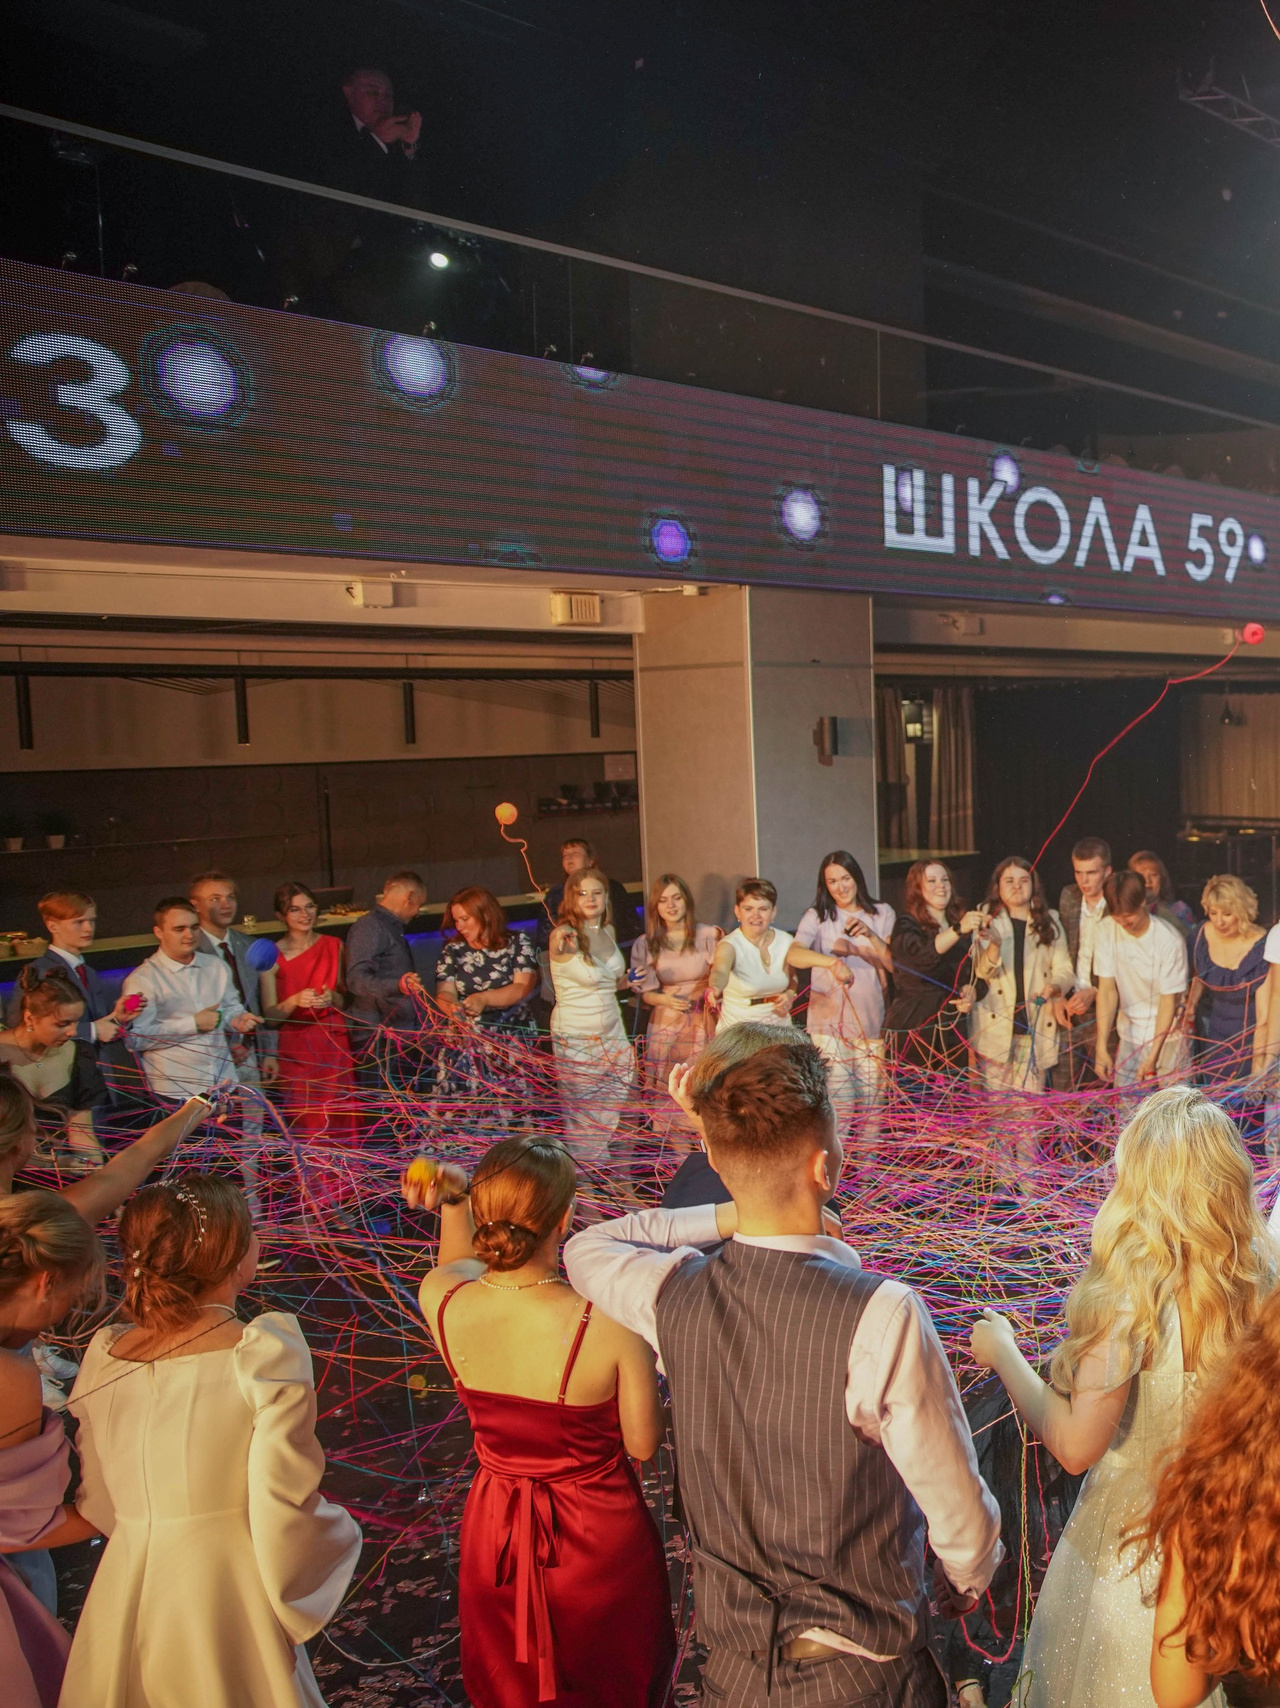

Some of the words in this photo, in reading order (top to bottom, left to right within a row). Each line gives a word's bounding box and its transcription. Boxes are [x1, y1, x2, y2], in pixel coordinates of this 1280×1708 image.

[8, 333, 142, 469] 3
[882, 464, 1166, 576] ШКОЛА
[1184, 513, 1245, 583] 59
